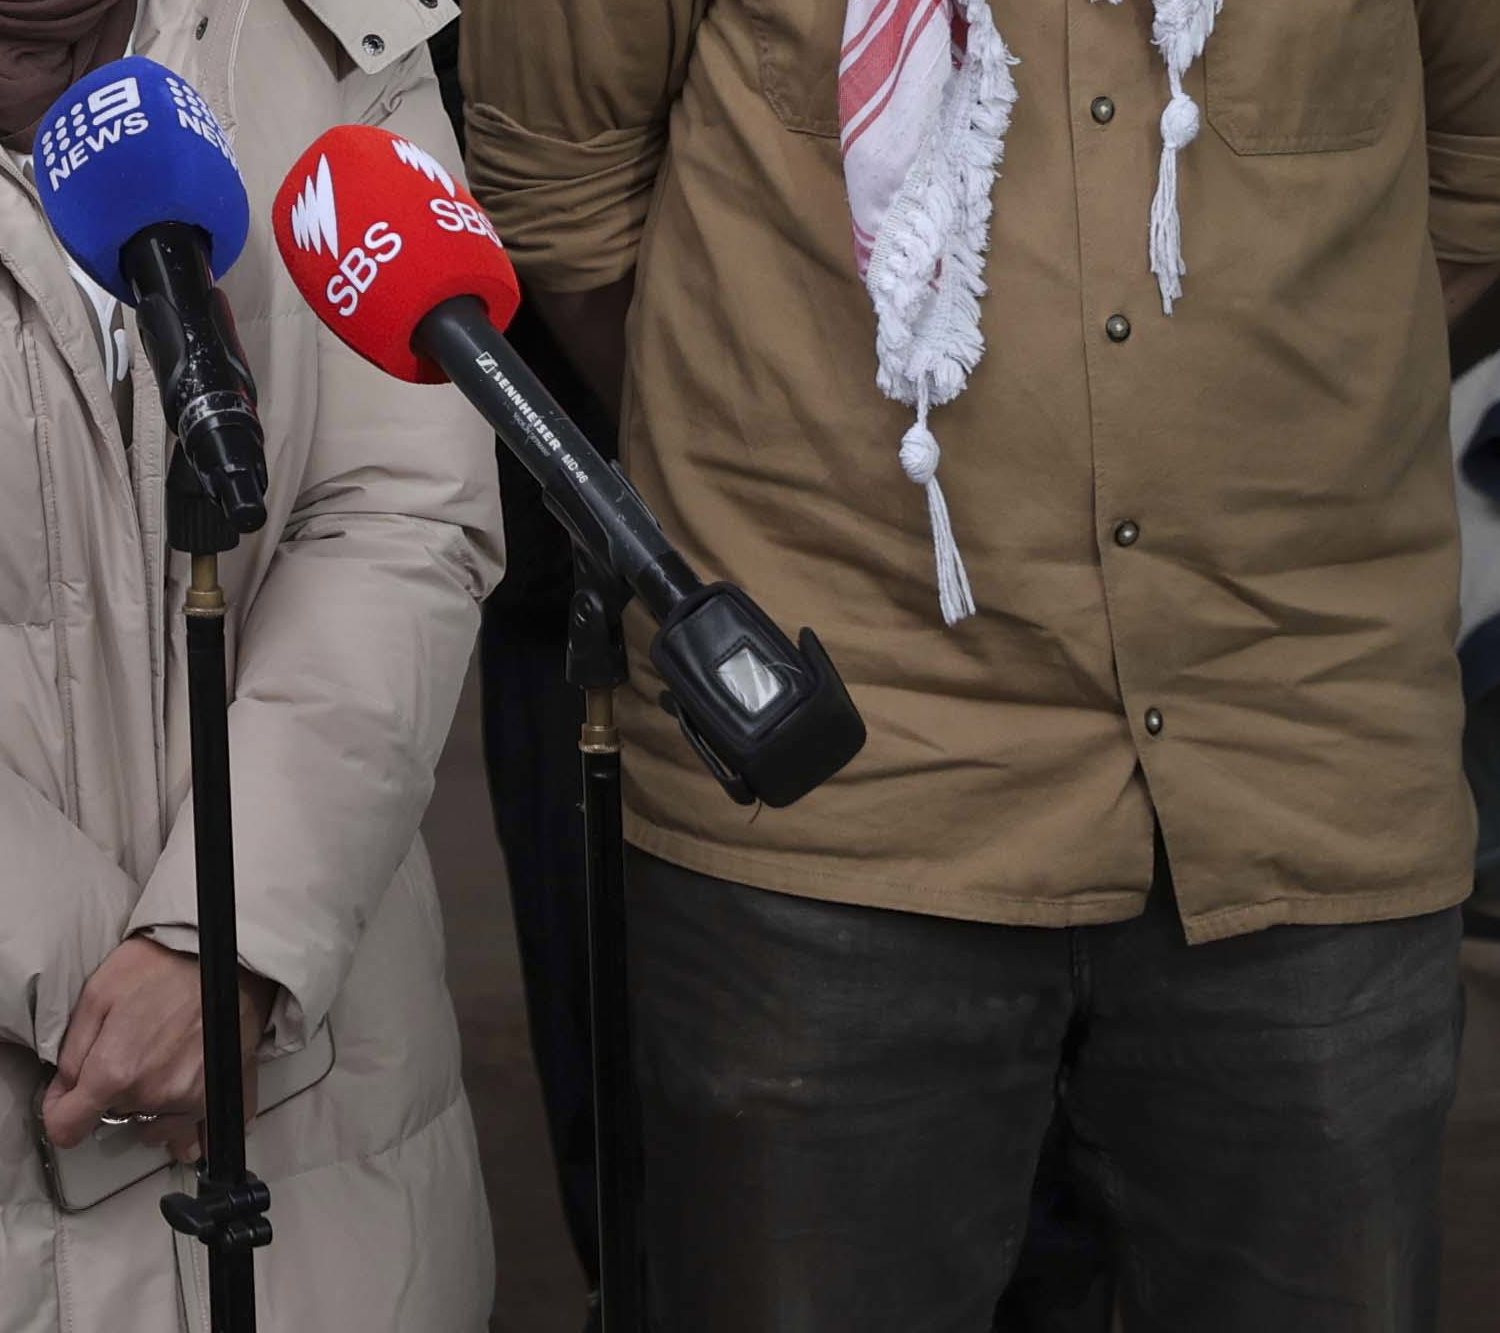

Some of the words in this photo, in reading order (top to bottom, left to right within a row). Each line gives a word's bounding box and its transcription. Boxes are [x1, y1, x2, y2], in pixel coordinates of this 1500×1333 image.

[49, 112, 149, 192] NEWS
[327, 221, 402, 317] SBS
[492, 371, 562, 451] SENNHEISER
[561, 453, 578, 472] MD
[576, 467, 589, 484] 46
